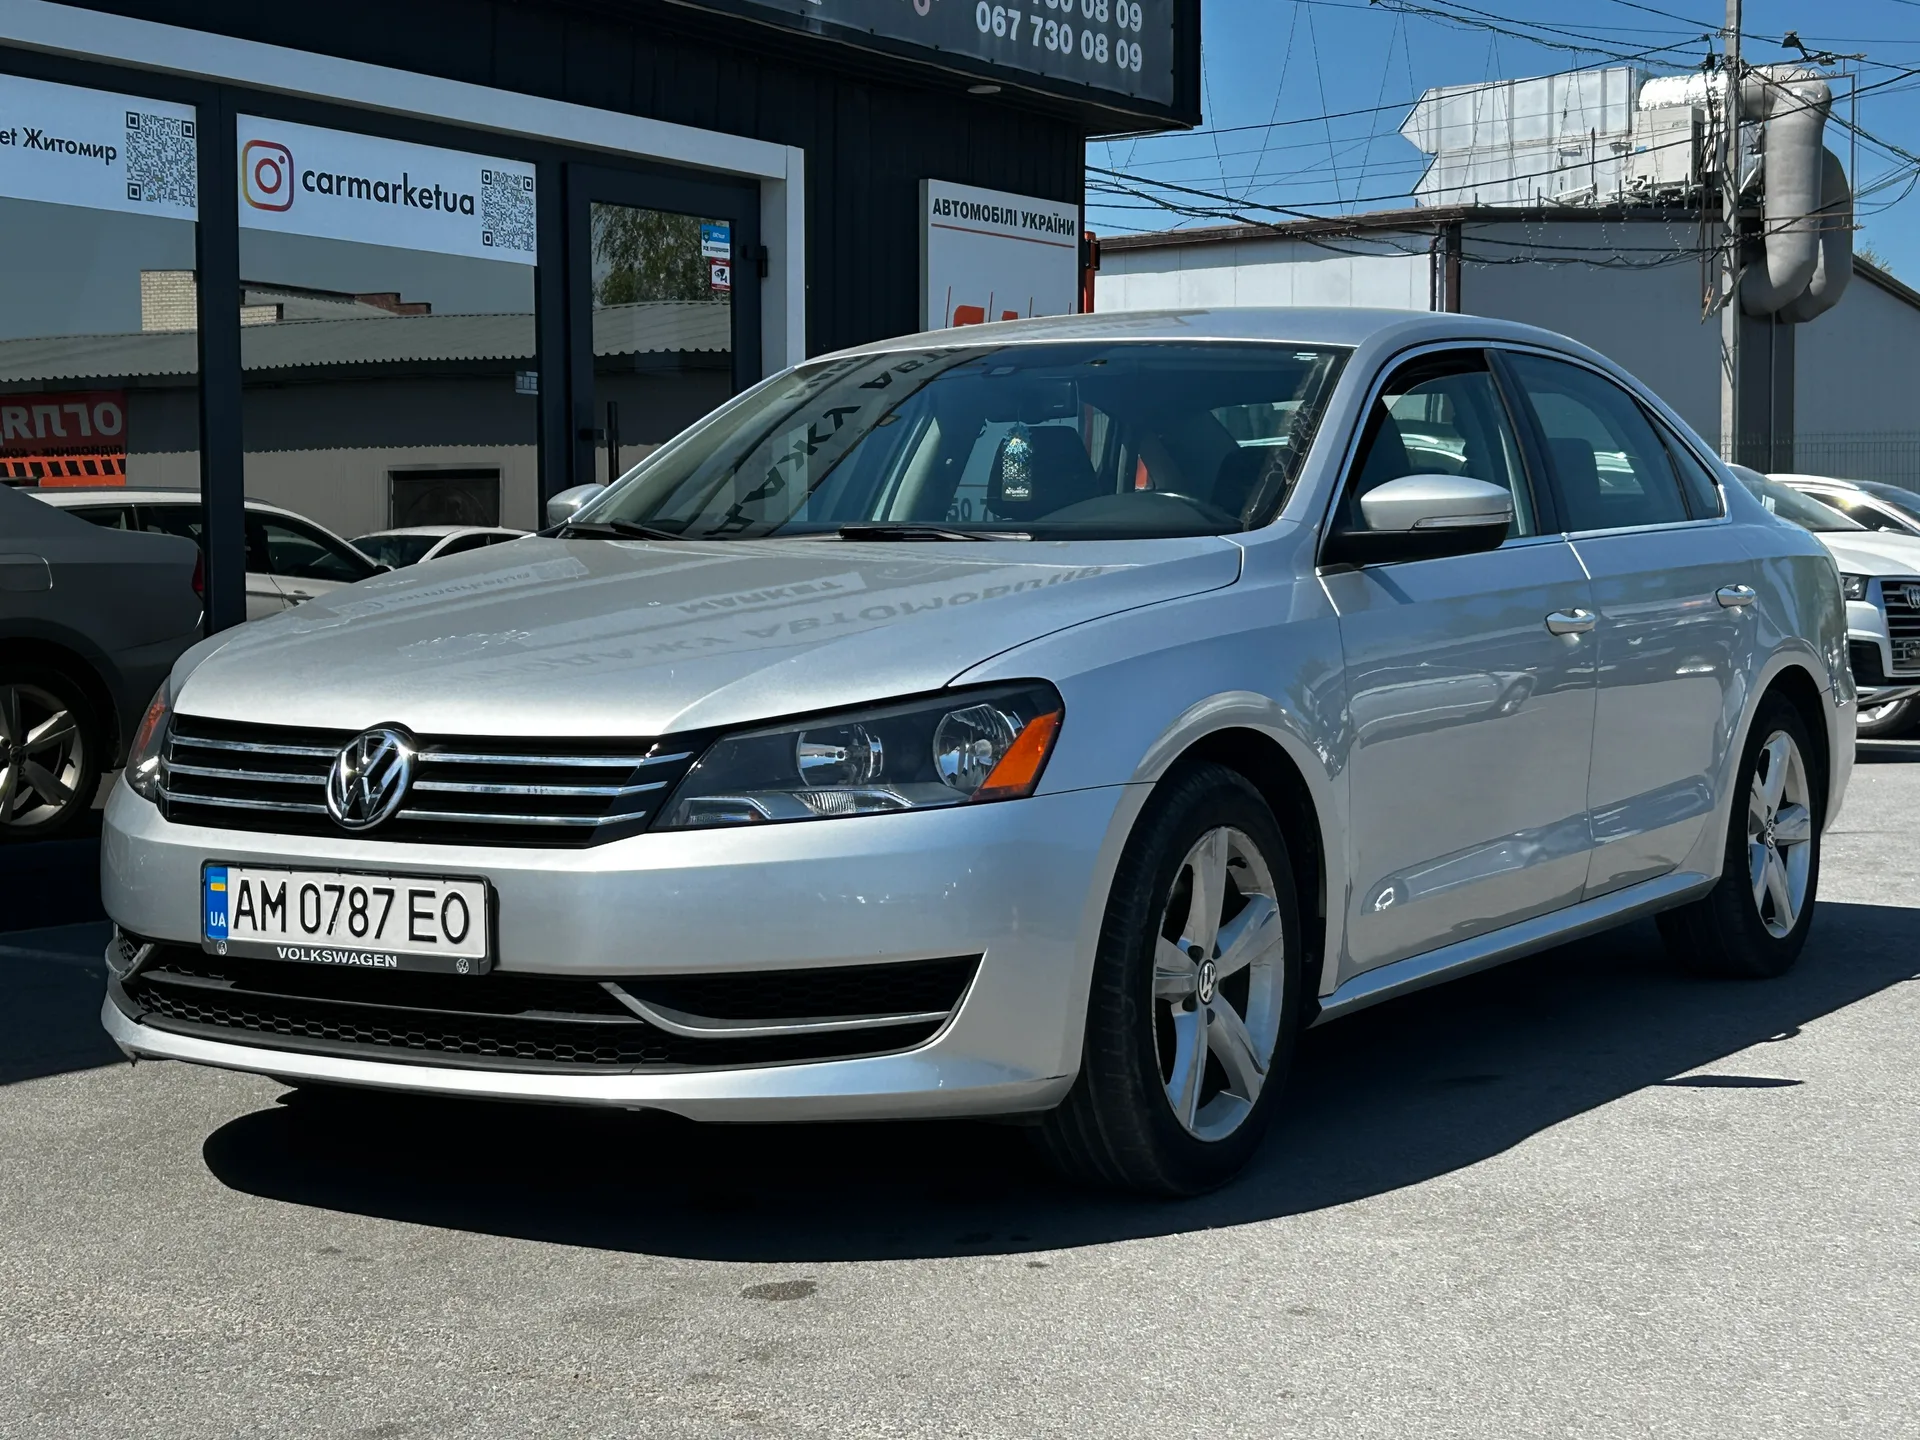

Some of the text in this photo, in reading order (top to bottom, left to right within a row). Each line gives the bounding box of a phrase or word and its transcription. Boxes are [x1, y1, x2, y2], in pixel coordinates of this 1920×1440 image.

[1116, 0, 1142, 32] 09
[976, 1, 1142, 72] 067 730 08 09
[23, 127, 117, 165] Житомир
[302, 170, 475, 216] carmarketua
[932, 198, 1075, 236] АВТОМОБІЛІ УКРАЇНИ
[210, 910, 227, 928] UA
[233, 878, 470, 944] AM 0787 EO
[277, 946, 397, 968] VOLKSWAGEN
